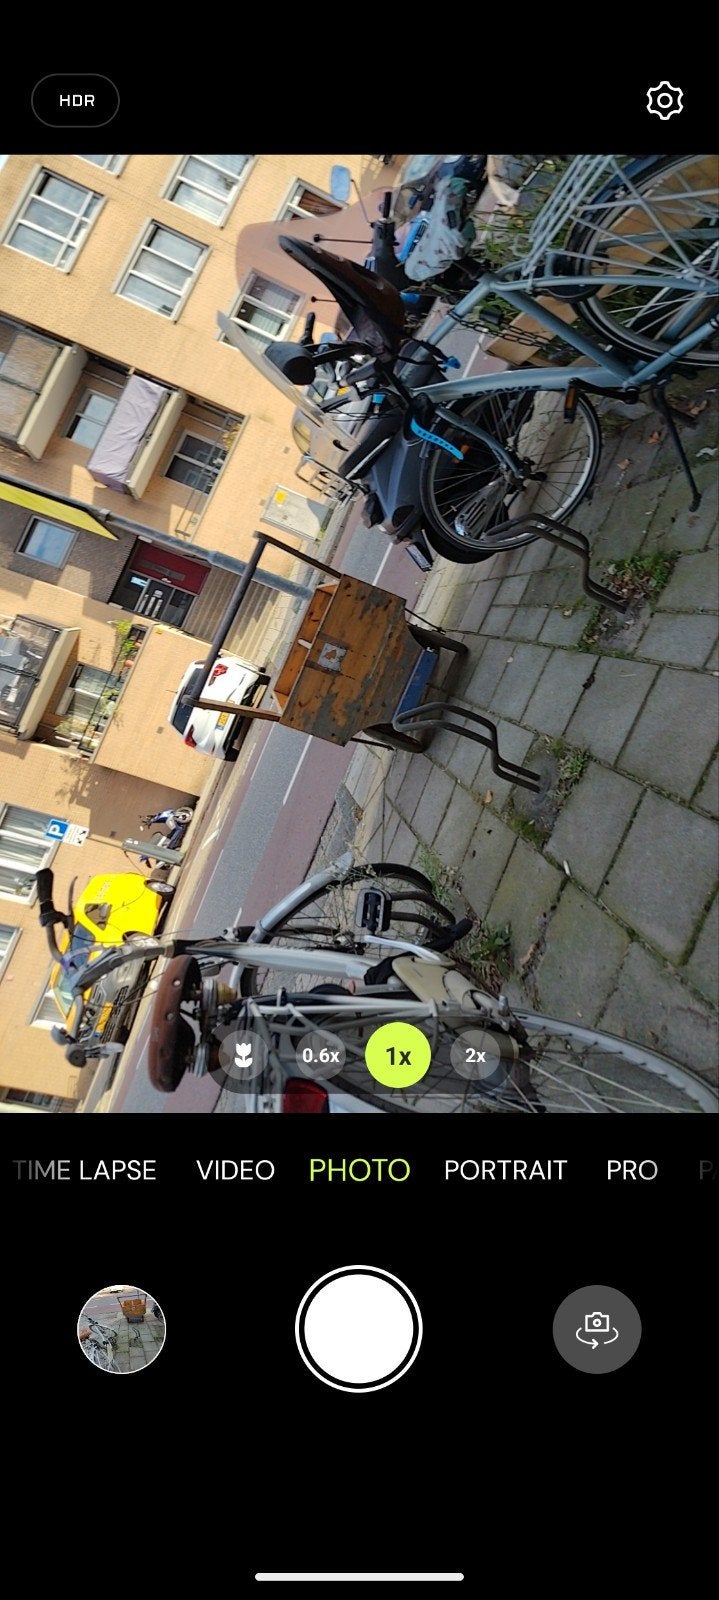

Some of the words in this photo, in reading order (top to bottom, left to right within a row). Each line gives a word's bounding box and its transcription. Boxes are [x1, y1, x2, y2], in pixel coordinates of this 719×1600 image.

[59, 94, 95, 107] HDR
[48, 824, 64, 837] P
[302, 1047, 340, 1063] 0.6x
[386, 1046, 412, 1066] 1x
[465, 1047, 486, 1063] 2x
[12, 1159, 71, 1181] TIME
[79, 1159, 157, 1181] LAPSE
[195, 1159, 276, 1181] VIDEO
[309, 1157, 411, 1183] PHOTO
[444, 1159, 568, 1181] PORTRAIT
[607, 1159, 659, 1181] PRO
